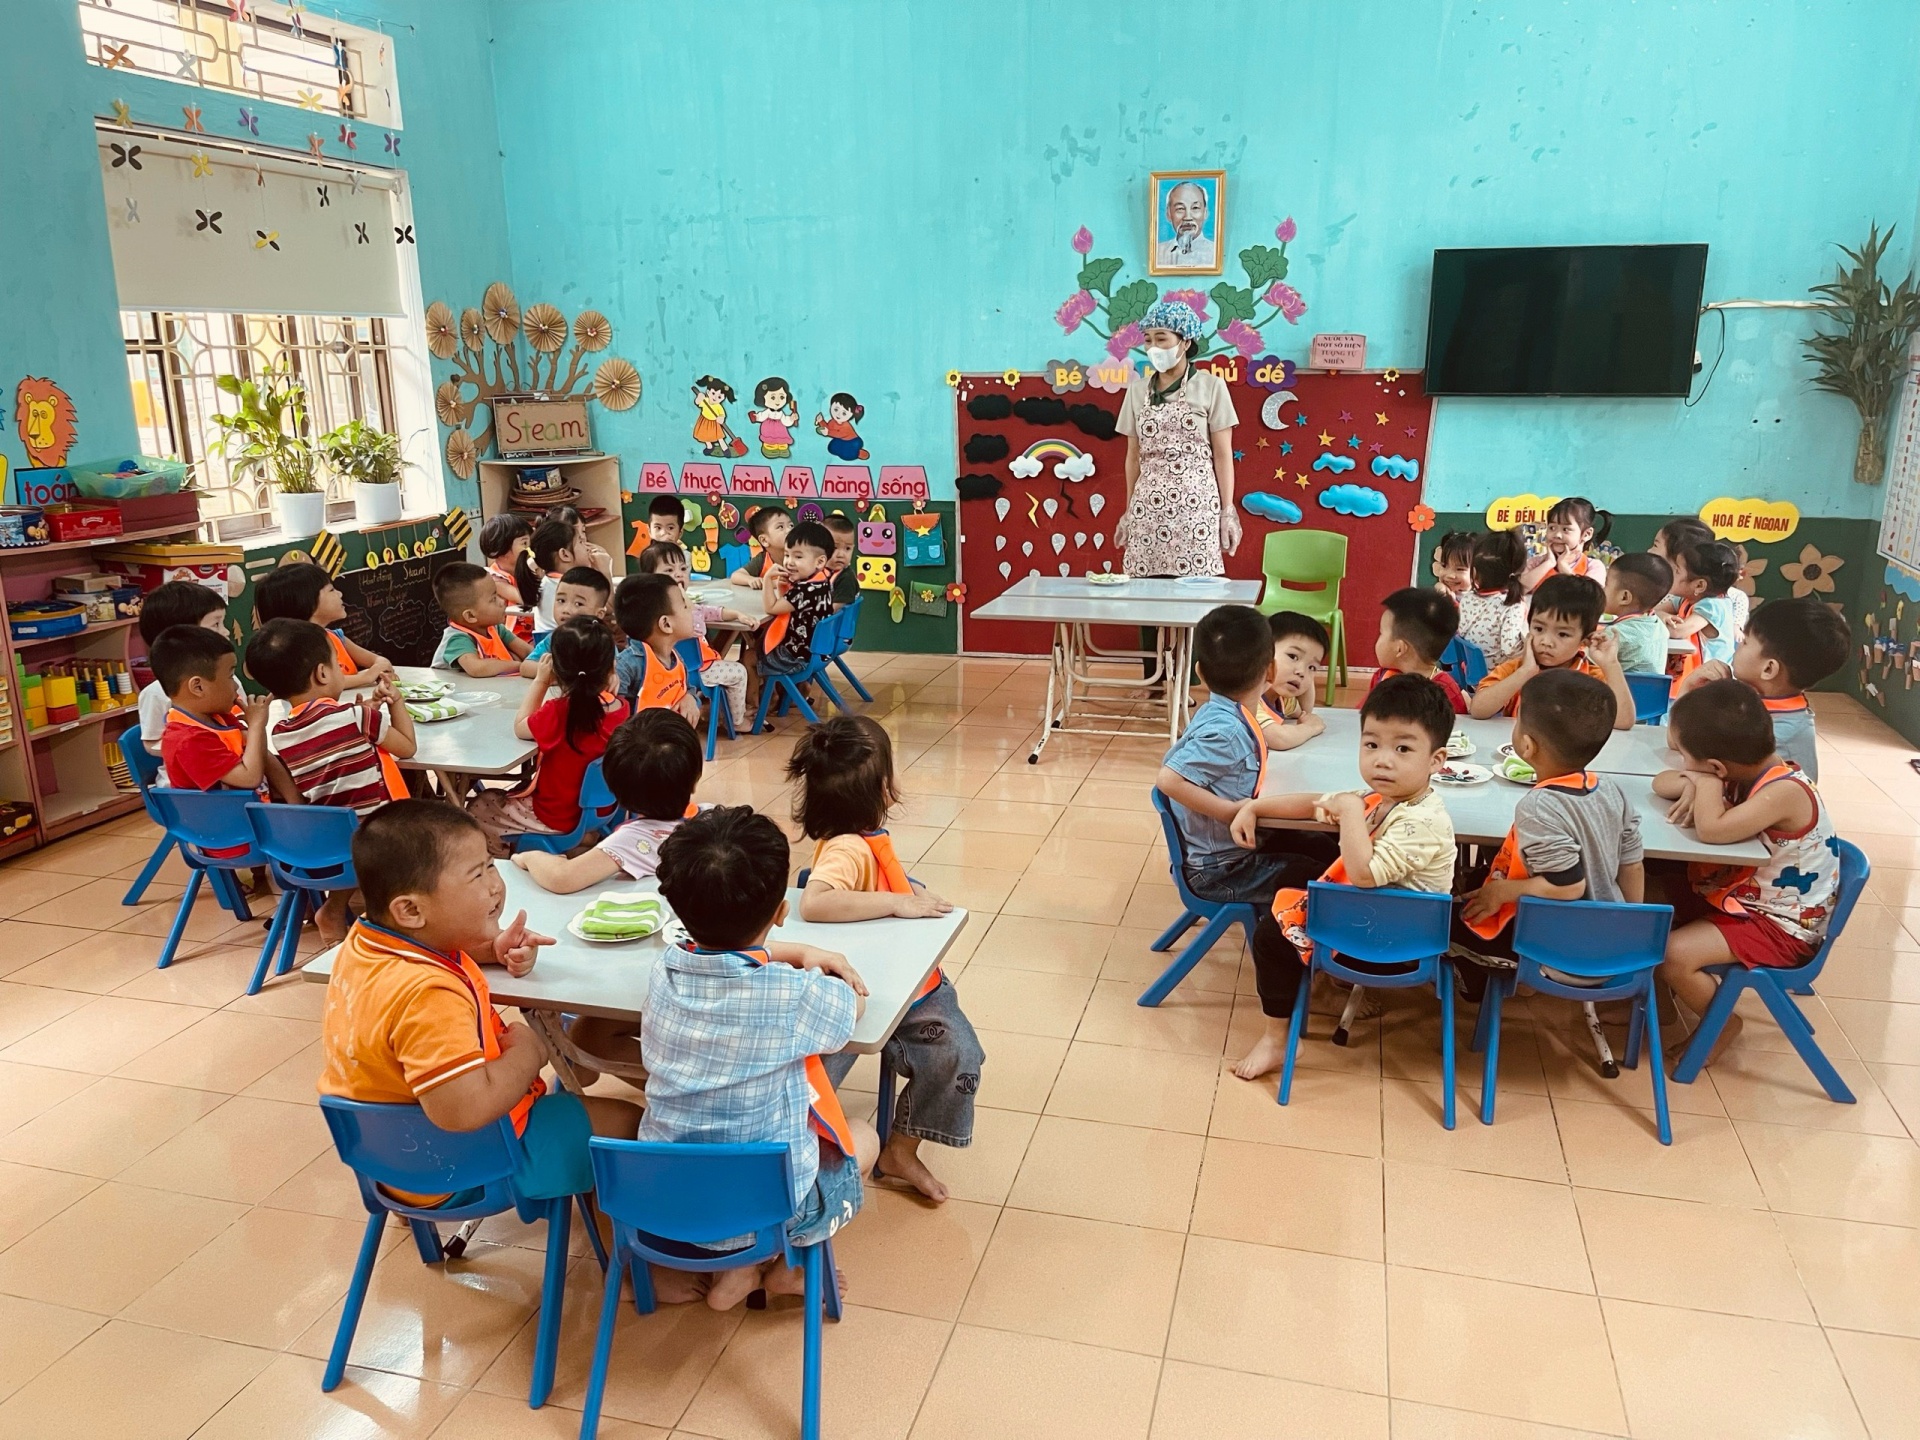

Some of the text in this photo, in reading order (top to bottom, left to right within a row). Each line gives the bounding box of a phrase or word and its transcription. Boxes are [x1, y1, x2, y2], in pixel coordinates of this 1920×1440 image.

[1056, 365, 1082, 386] Bé
[1098, 364, 1129, 384] vui
[1198, 360, 1238, 382] hủ
[1255, 361, 1285, 384] đề
[506, 411, 584, 443] Steam
[646, 470, 926, 497] Bé thực hành kỹ năng sống
[1497, 506, 1510, 523] BÉ
[1515, 506, 1536, 523] ĐẾN
[1712, 512, 1790, 532] HOA BÉ NGOAN
[416, 544, 424, 557] 4
[428, 540, 435, 552] 5
